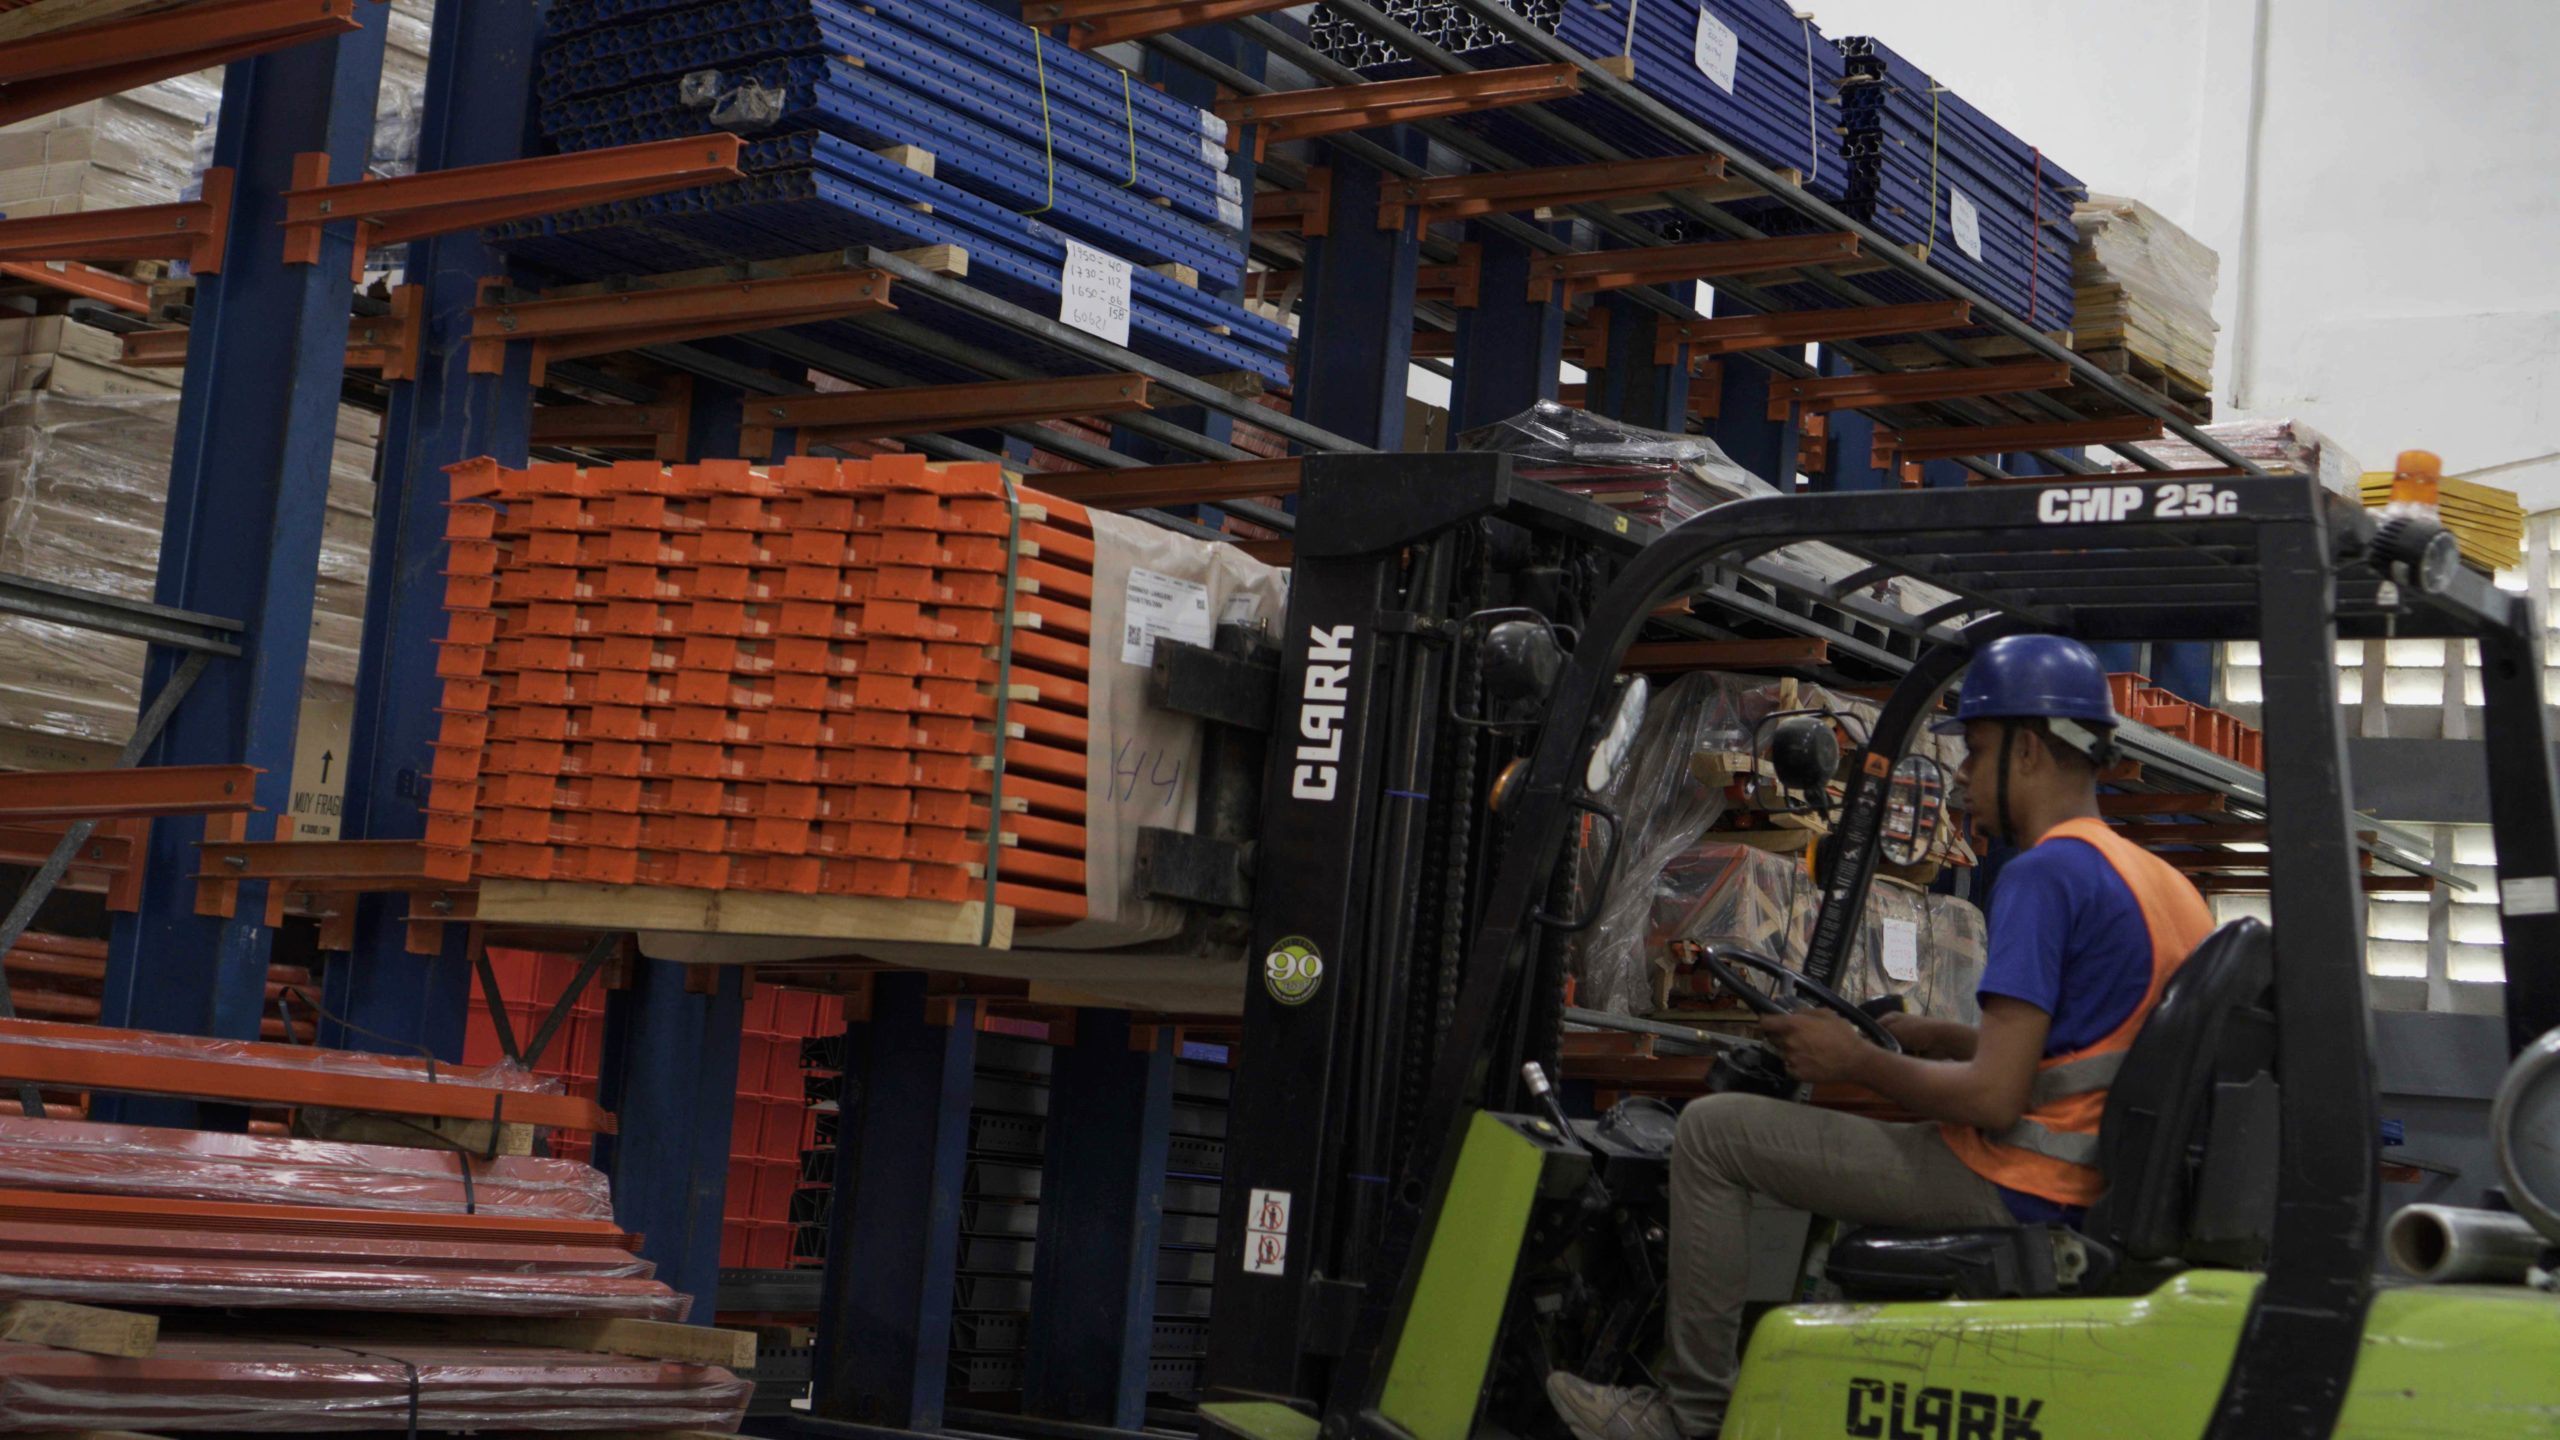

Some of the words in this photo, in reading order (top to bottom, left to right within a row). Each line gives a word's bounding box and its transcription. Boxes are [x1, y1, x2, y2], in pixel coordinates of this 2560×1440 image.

[2154, 483, 2239, 517] 25G
[1292, 624, 1355, 802] CLARK
[293, 791, 315, 814] MUY
[1266, 951, 1323, 981] 90
[1846, 1377, 2045, 1440] CLARK
